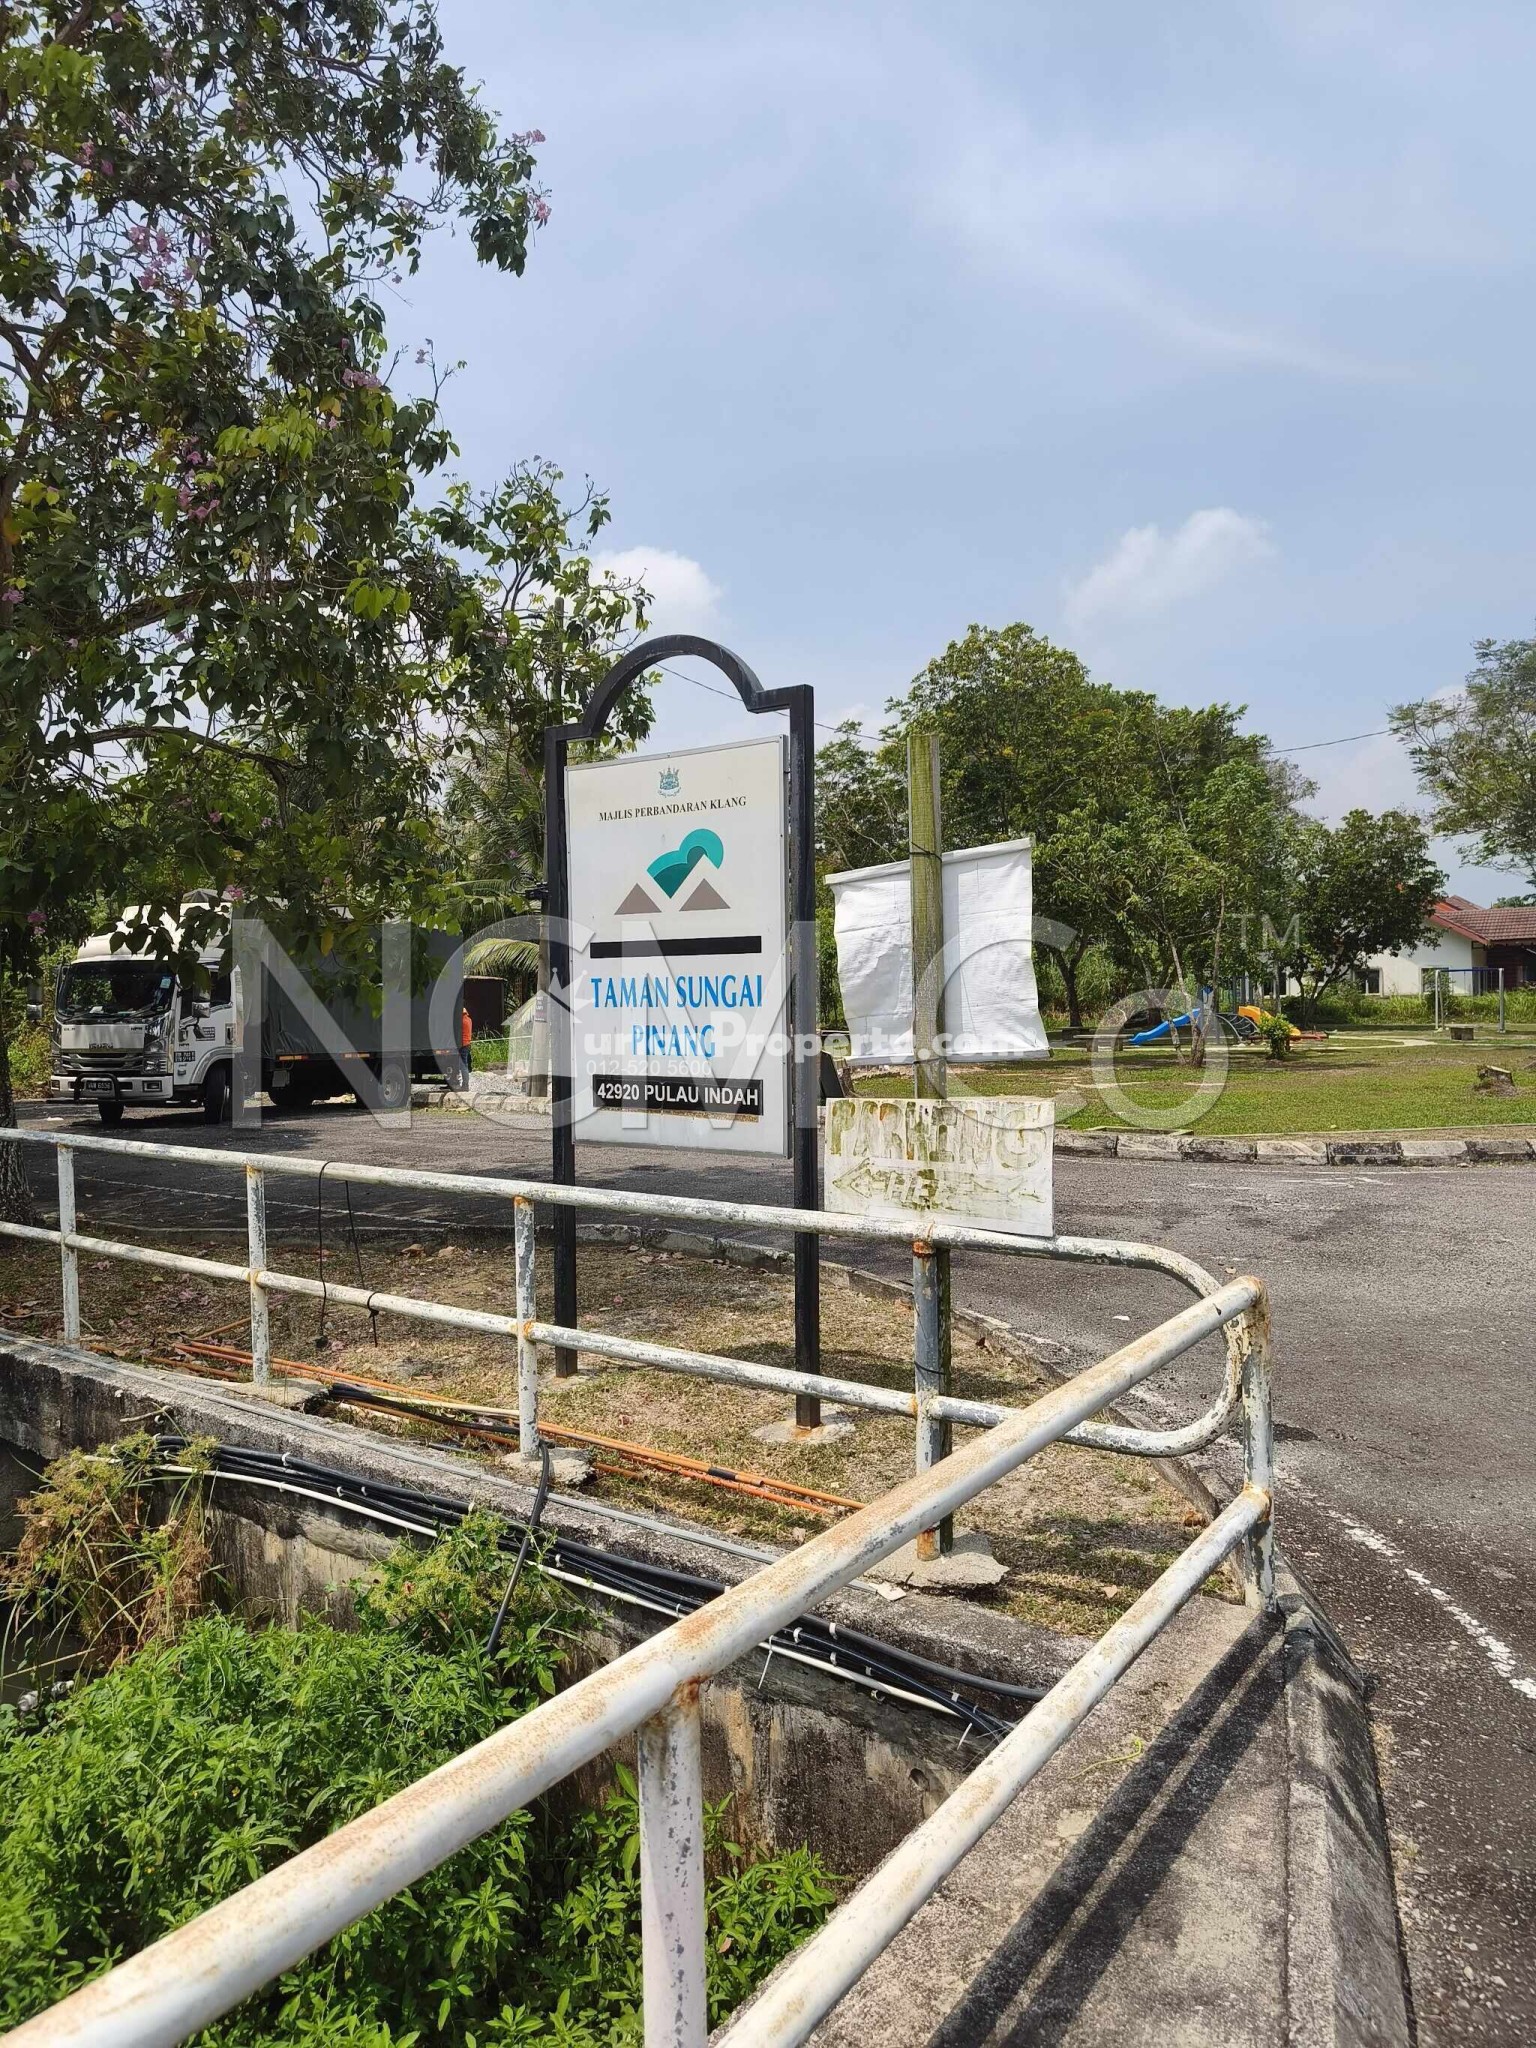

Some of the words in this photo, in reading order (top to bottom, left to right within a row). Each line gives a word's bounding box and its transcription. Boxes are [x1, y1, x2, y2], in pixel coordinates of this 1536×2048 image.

[599, 808, 633, 822] MAJLIS
[635, 800, 708, 819] PERBANDARAN
[710, 796, 746, 810] KLANG
[590, 977, 669, 1008] TAMAN
[676, 974, 763, 1008] SUNGAI
[632, 1024, 715, 1058] PINANG
[597, 1083, 640, 1101] 42920
[644, 1083, 699, 1104] PULAU
[704, 1087, 759, 1106] INDAH
